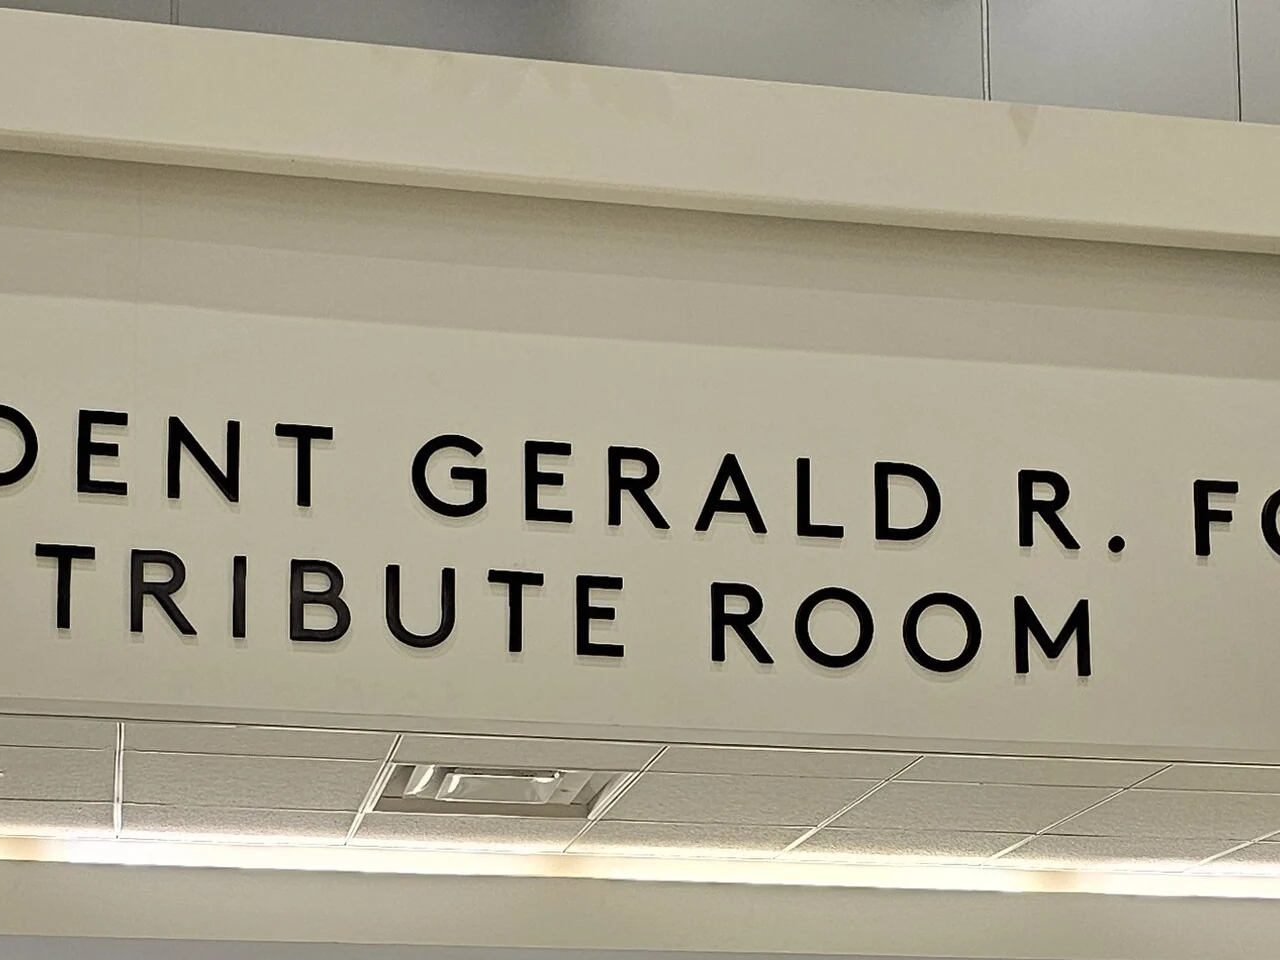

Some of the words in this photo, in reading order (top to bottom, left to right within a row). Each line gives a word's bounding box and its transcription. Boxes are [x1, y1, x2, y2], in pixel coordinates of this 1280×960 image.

[410, 433, 942, 543] GERALD
[1018, 469, 1126, 554] R.
[35, 543, 624, 658] TRIBUTE
[709, 581, 1092, 677] ROOM
